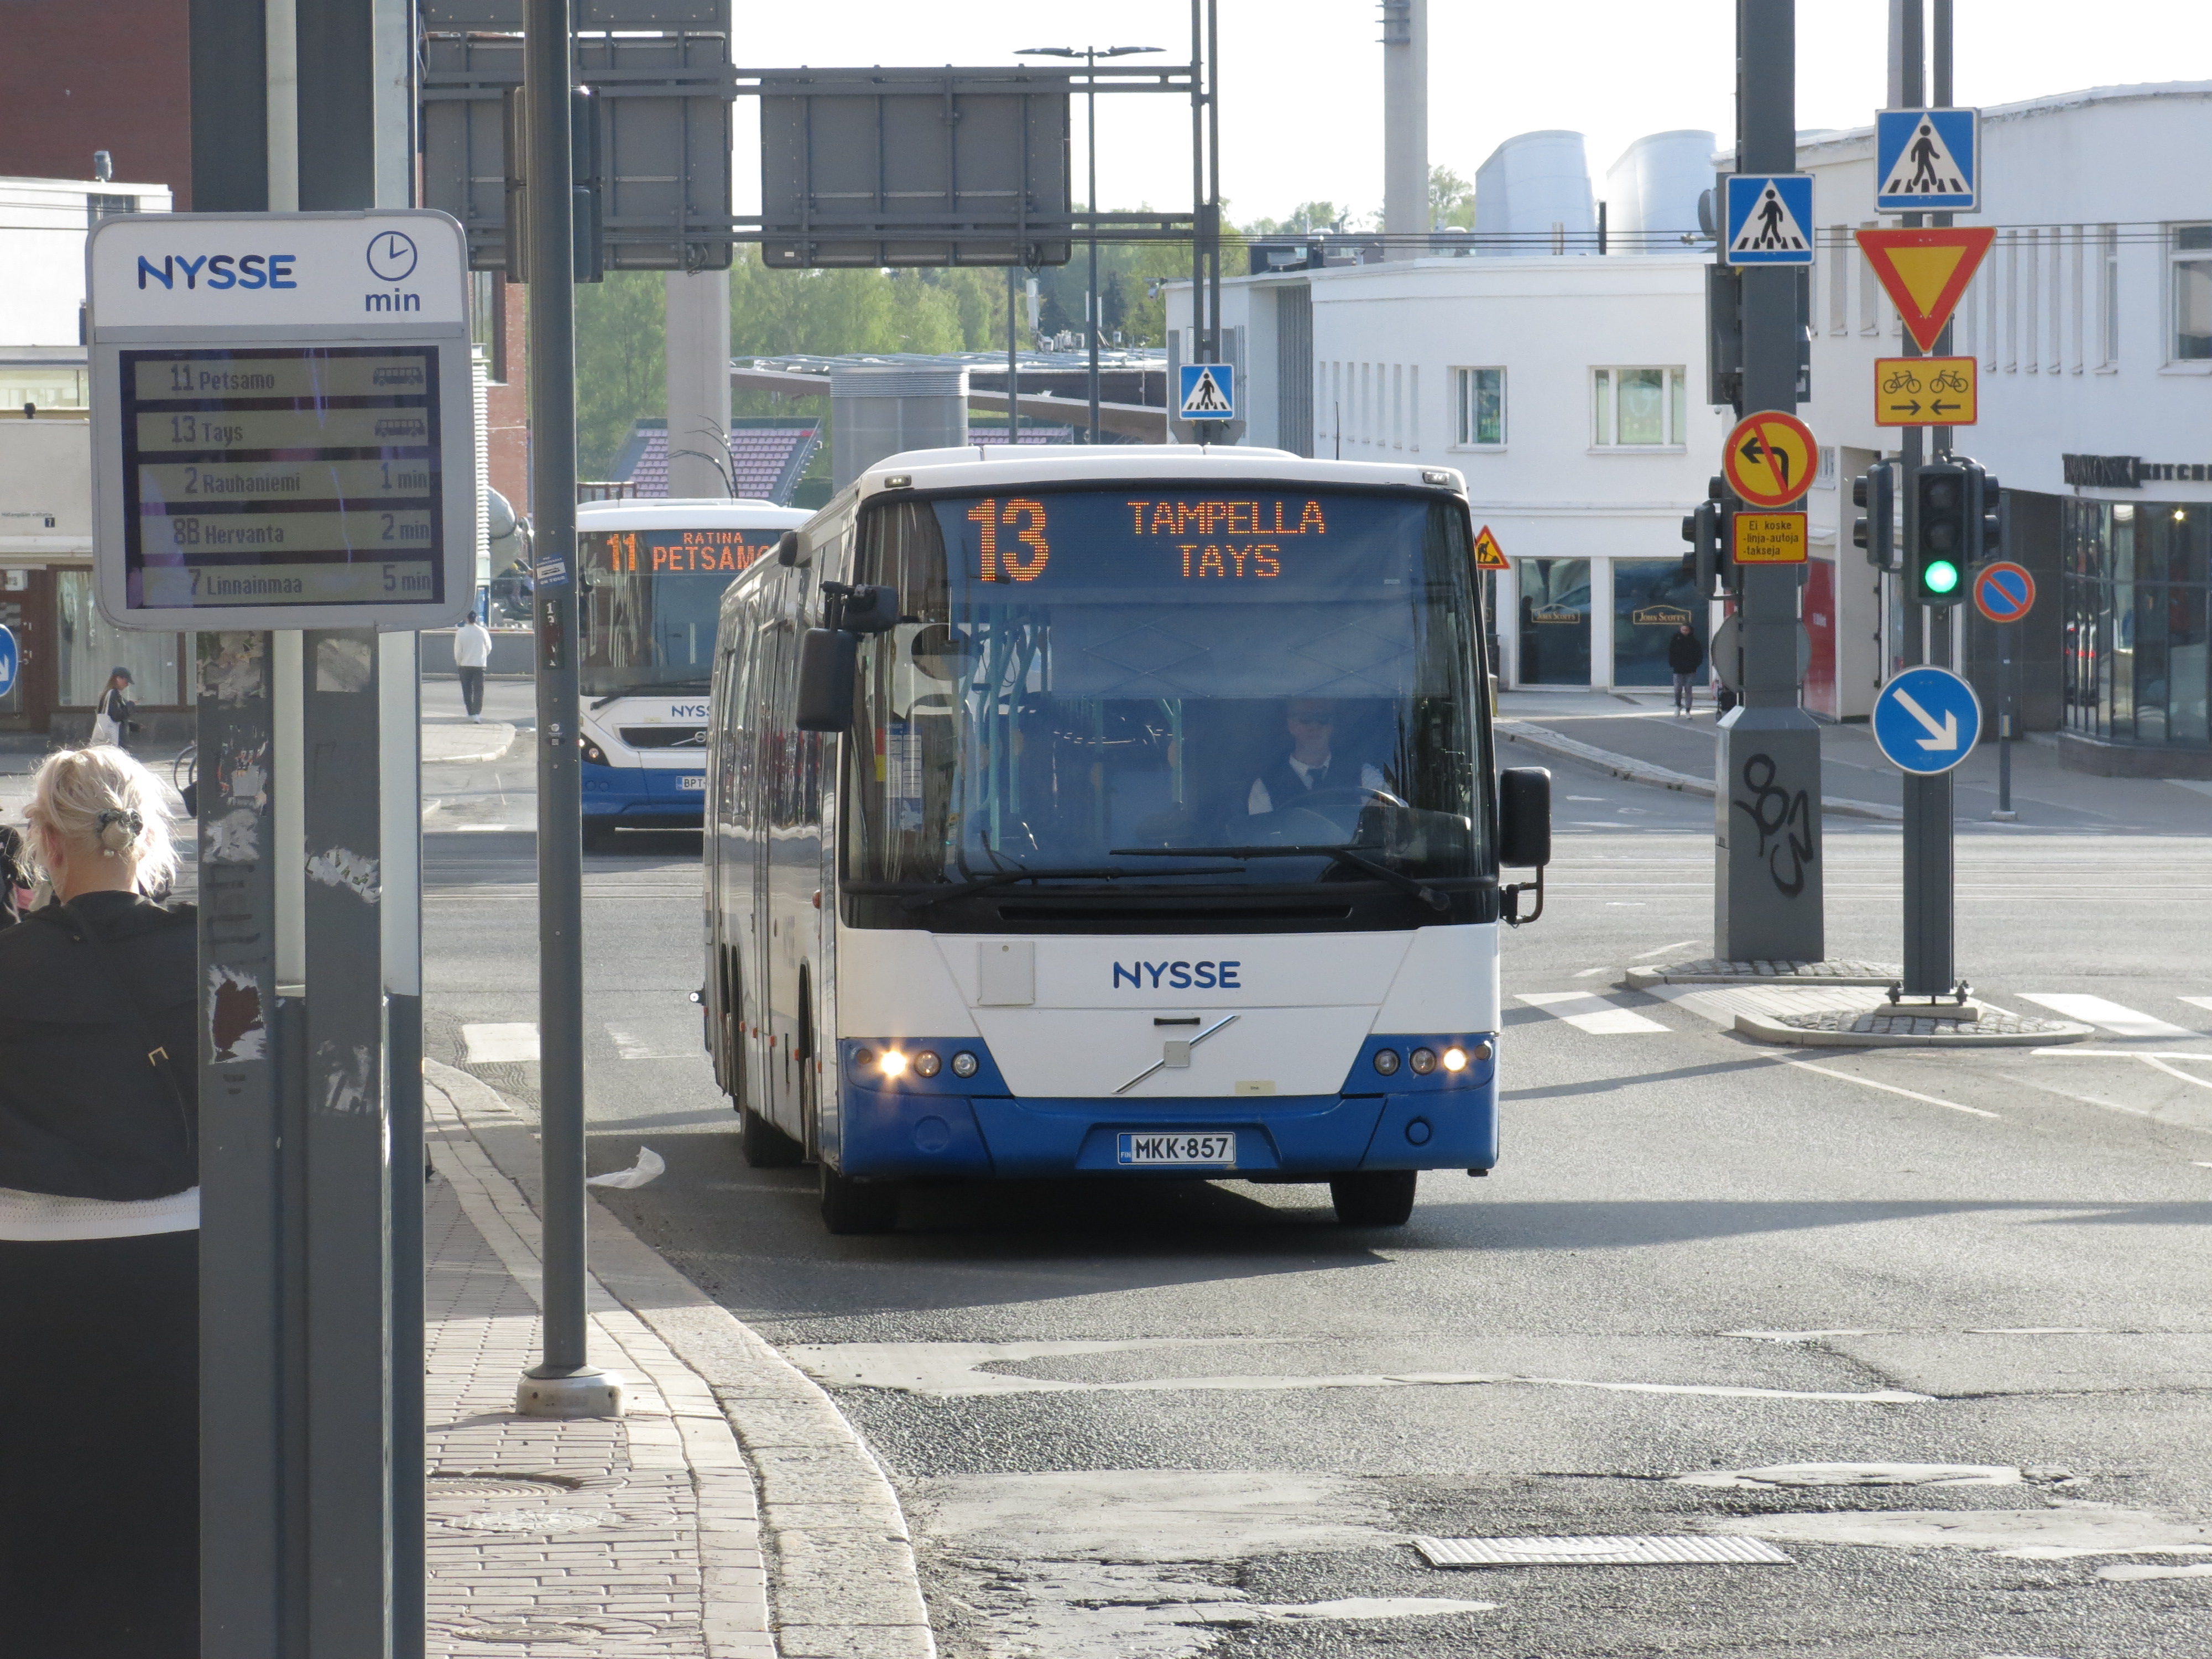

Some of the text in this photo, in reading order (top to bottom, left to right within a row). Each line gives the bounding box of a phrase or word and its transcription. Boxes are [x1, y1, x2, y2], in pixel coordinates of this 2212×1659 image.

[138, 254, 298, 289] NYSSE
[365, 288, 421, 312] min
[170, 363, 275, 392] 11 Petsamo
[171, 415, 243, 447] 13 Tays
[184, 462, 428, 494] 2 Rauhaniemi 1 min
[174, 513, 430, 545] 8B Hervanta 2 min
[1126, 501, 1326, 534] TAMPELLA
[1749, 520, 1792, 530] Ei koske
[607, 533, 635, 571] 11
[683, 532, 743, 544] RATINA
[968, 499, 1048, 582] 13
[1177, 545, 1280, 577] TAYS
[189, 564, 432, 596] 7 Linnainmaa 5 min
[1113, 961, 1241, 988] NYSSE
[1135, 1138, 1229, 1159] MKK-857
